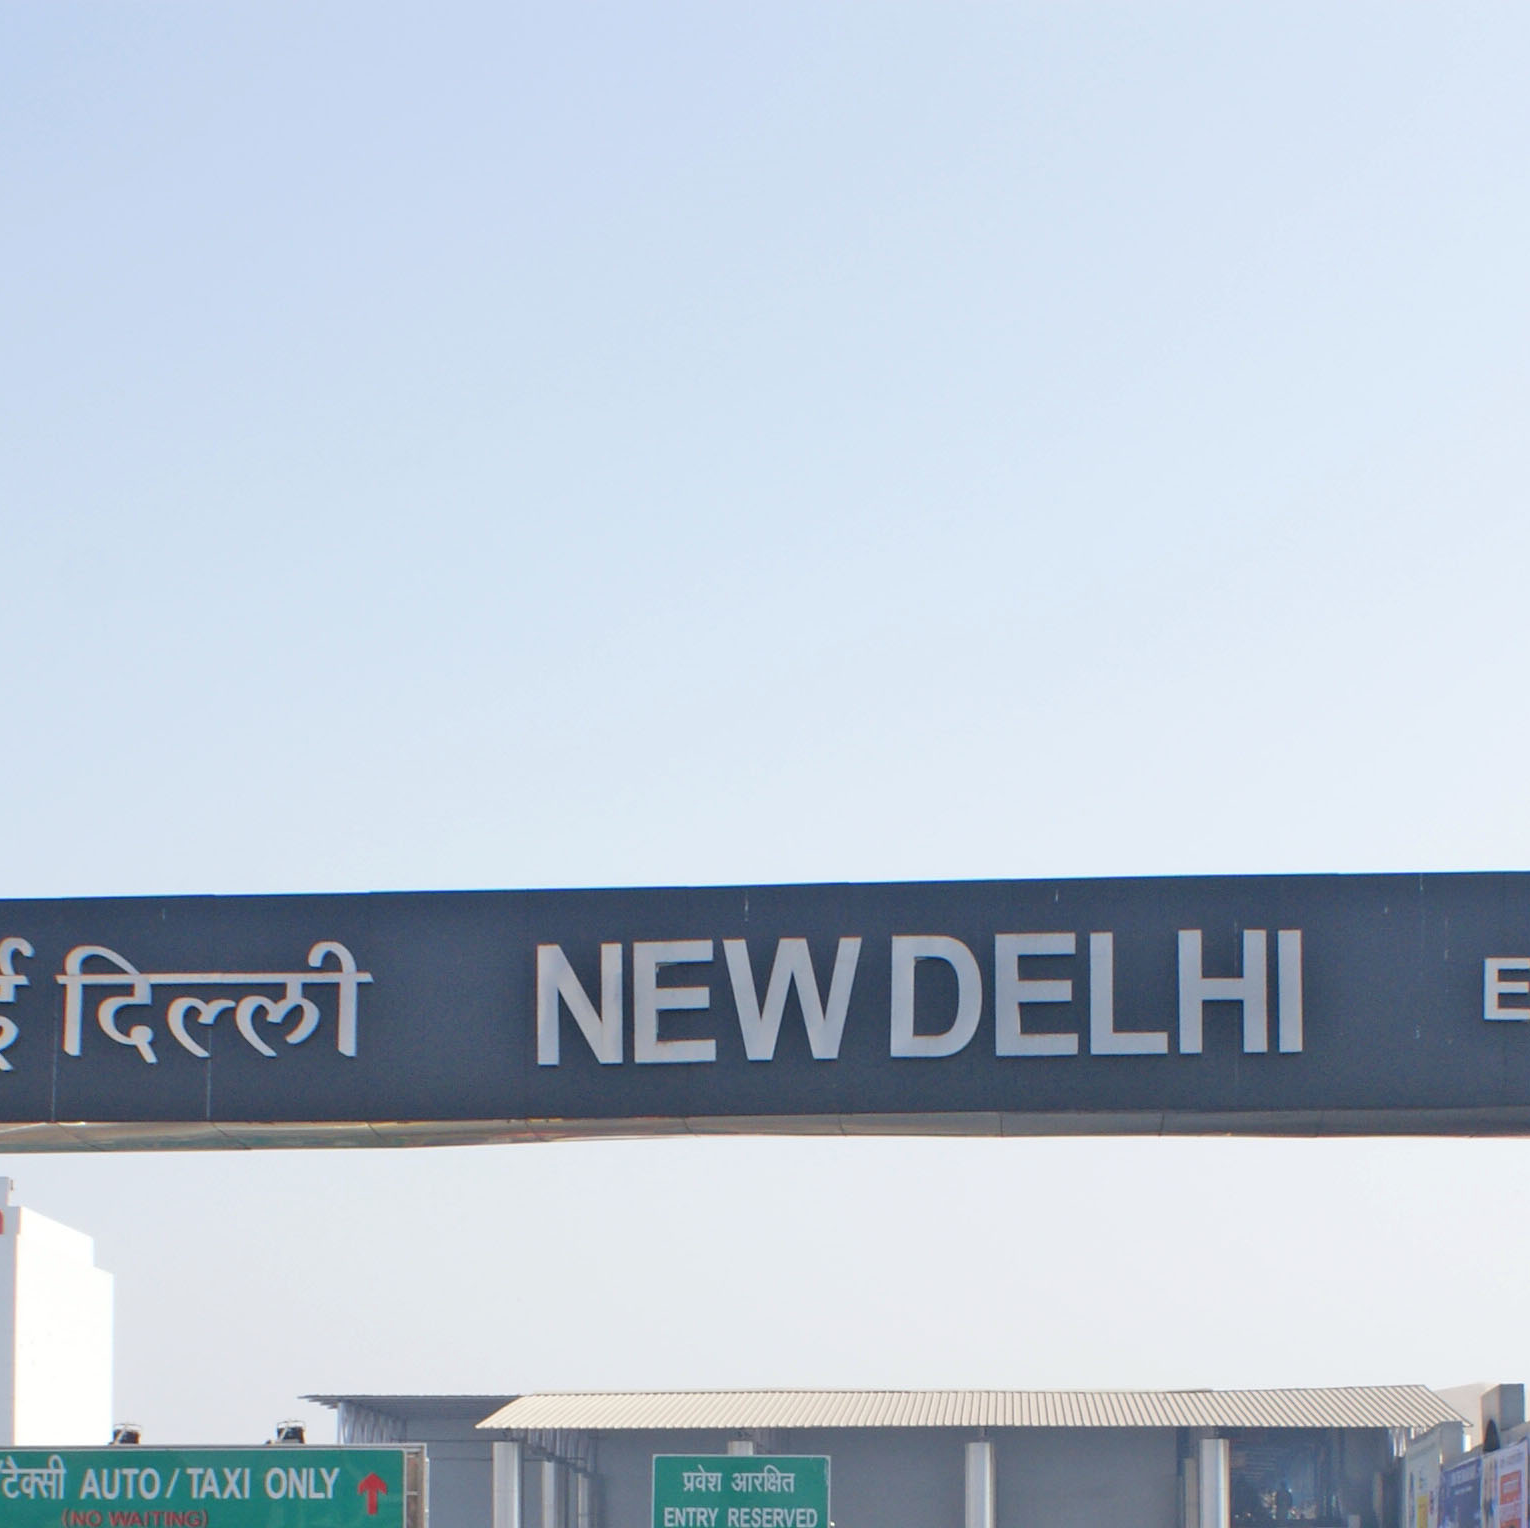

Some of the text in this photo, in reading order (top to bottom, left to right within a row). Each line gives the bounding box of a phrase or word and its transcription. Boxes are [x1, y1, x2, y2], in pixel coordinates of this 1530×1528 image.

[56, 941, 373, 1064] दिल्ली
[537, 938, 861, 1067] NEW
[890, 929, 1303, 1057] DELHI
[265, 1467, 340, 1500] ONLY
[682, 1464, 796, 1493] प्रवेश आरक्षित
[61, 1508, 208, 1528] (NO WAITING)
[664, 1507, 818, 1528] ENTRY RESERVED
